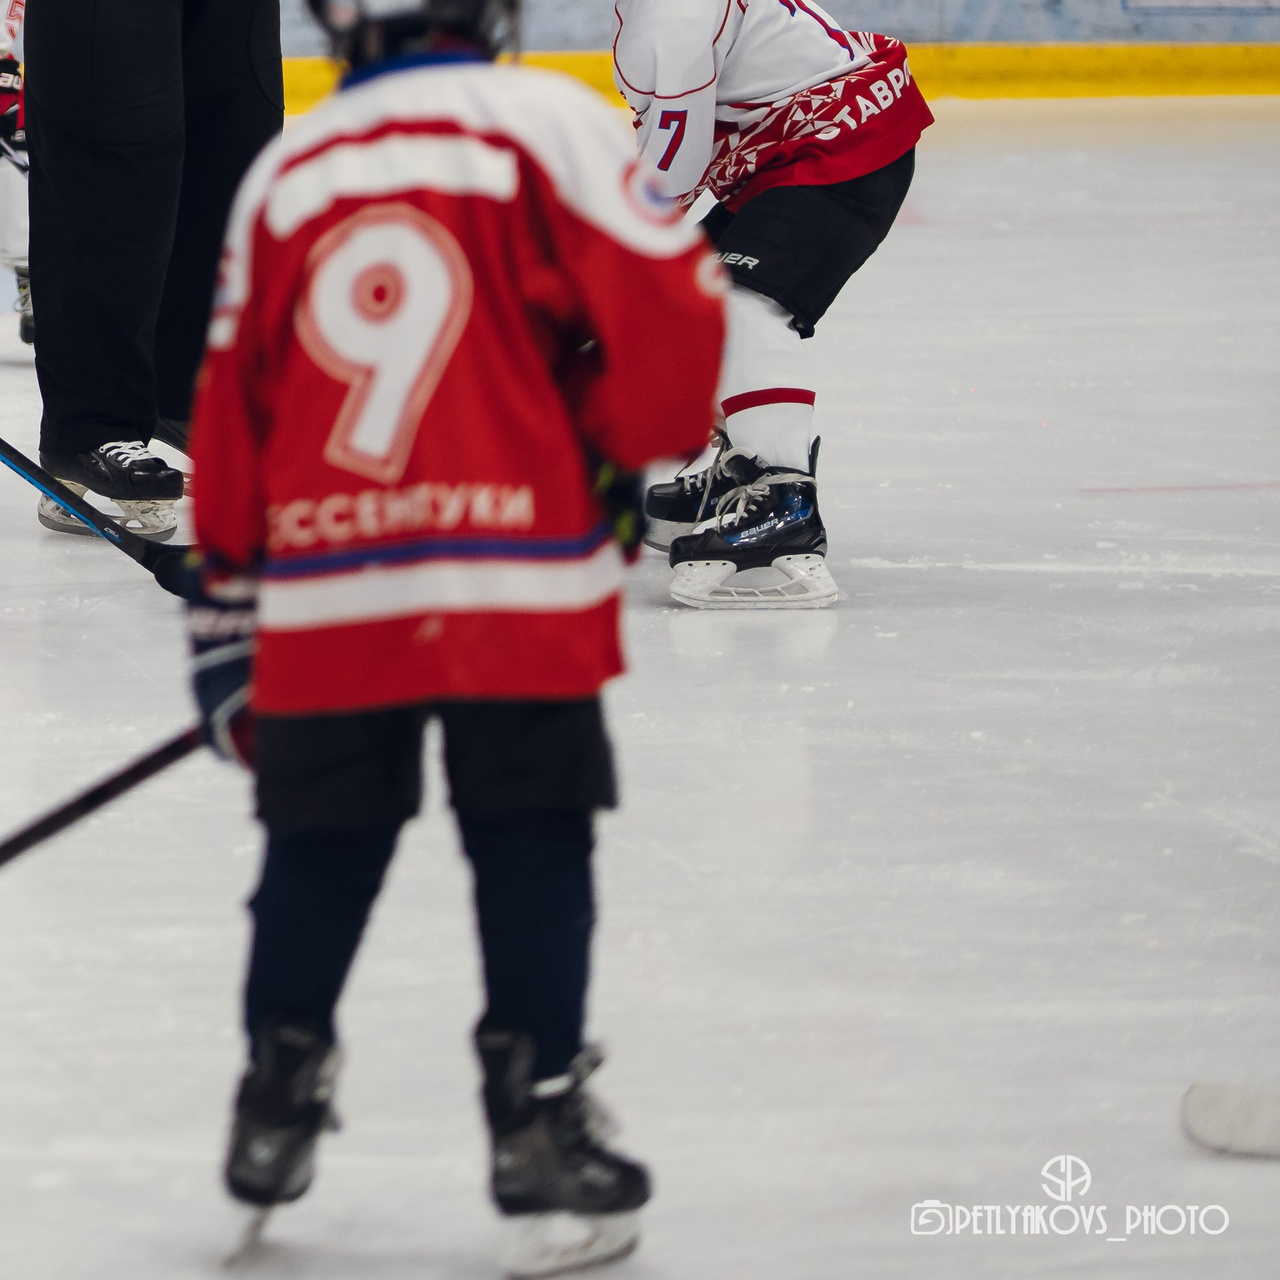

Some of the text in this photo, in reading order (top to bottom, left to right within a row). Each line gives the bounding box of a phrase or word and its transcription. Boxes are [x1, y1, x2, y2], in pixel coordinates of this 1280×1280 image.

[656, 110, 688, 172] 7
[296, 201, 474, 485] 9
[740, 517, 779, 538] BAUER
